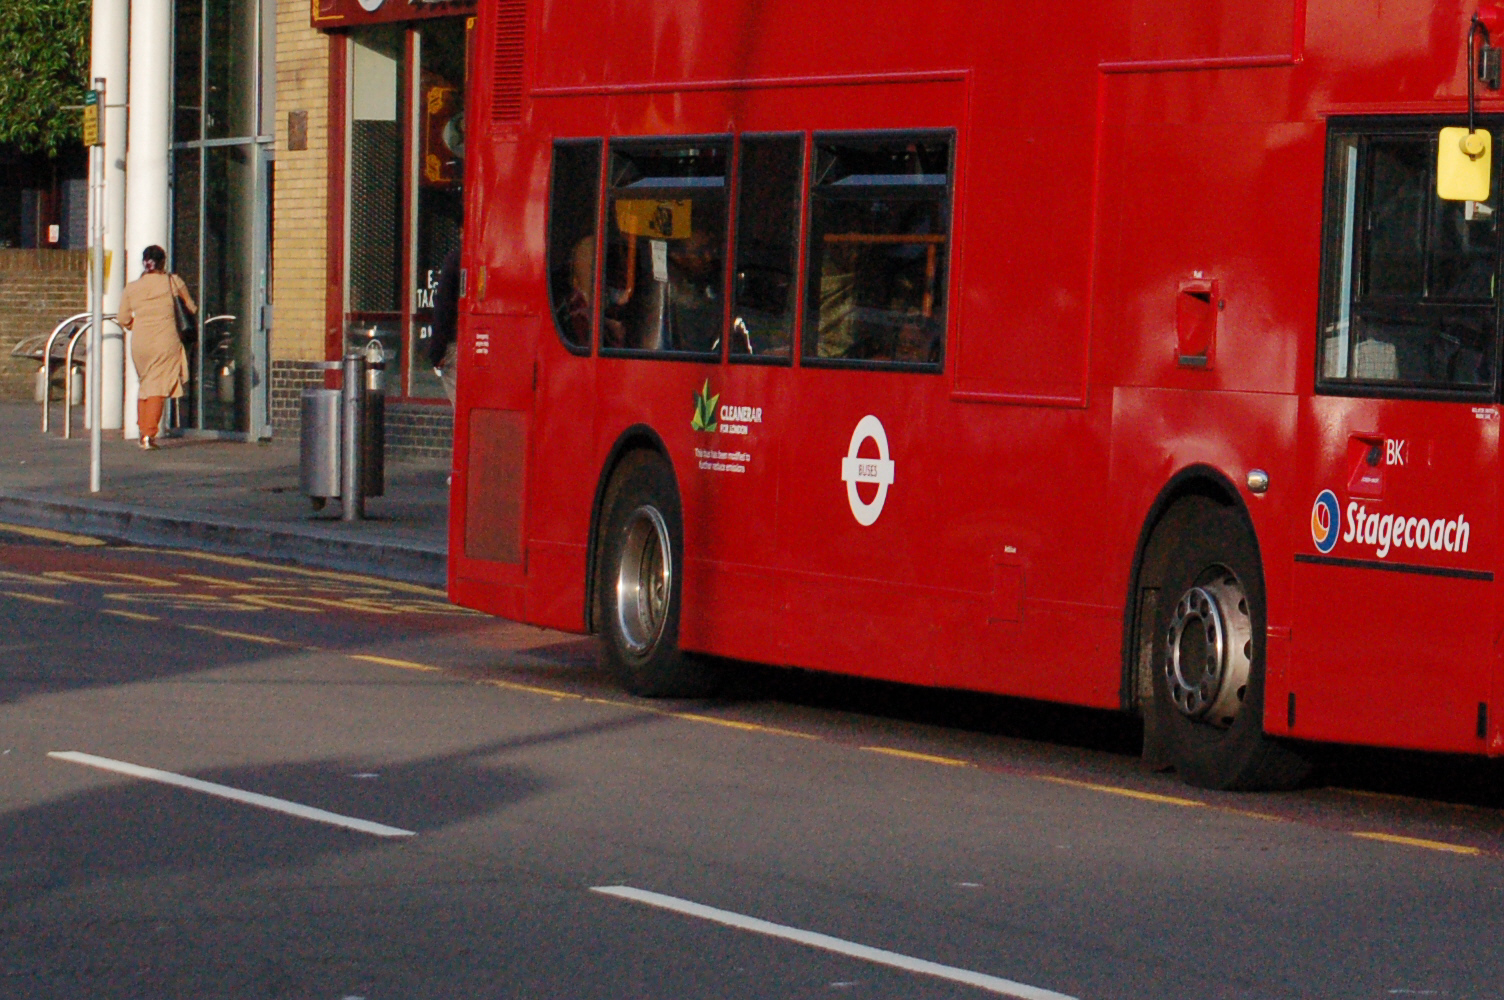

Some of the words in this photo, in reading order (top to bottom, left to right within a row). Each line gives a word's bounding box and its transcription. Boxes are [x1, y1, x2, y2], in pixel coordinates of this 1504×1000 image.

[1386, 438, 1405, 466] BK
[859, 464, 877, 477] BUSES
[1343, 501, 1470, 558] Stagecoach
